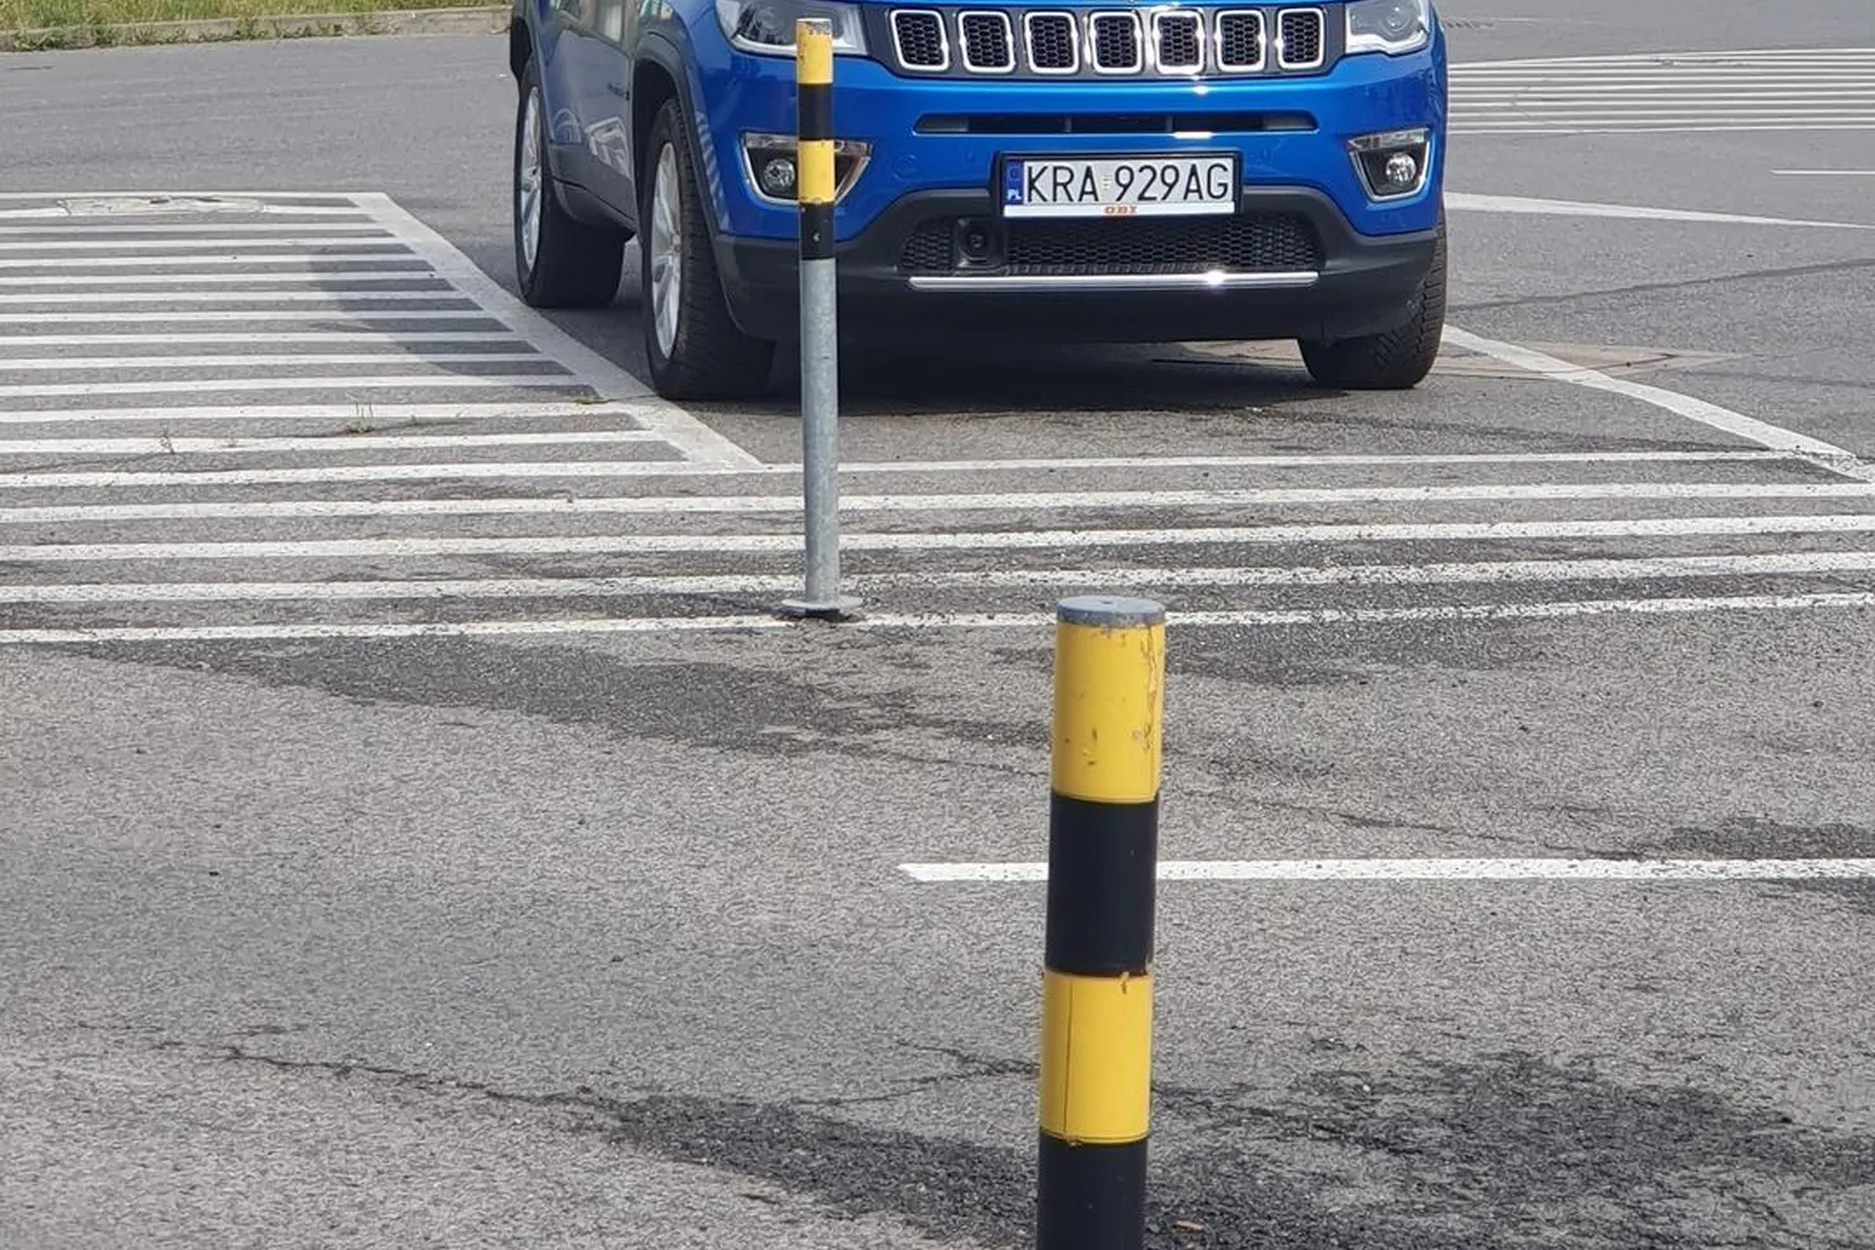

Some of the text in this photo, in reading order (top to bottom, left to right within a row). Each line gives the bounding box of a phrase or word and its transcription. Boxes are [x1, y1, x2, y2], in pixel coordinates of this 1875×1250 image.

[1008, 188, 1021, 200] PL
[1027, 163, 1229, 203] KRA 929AG
